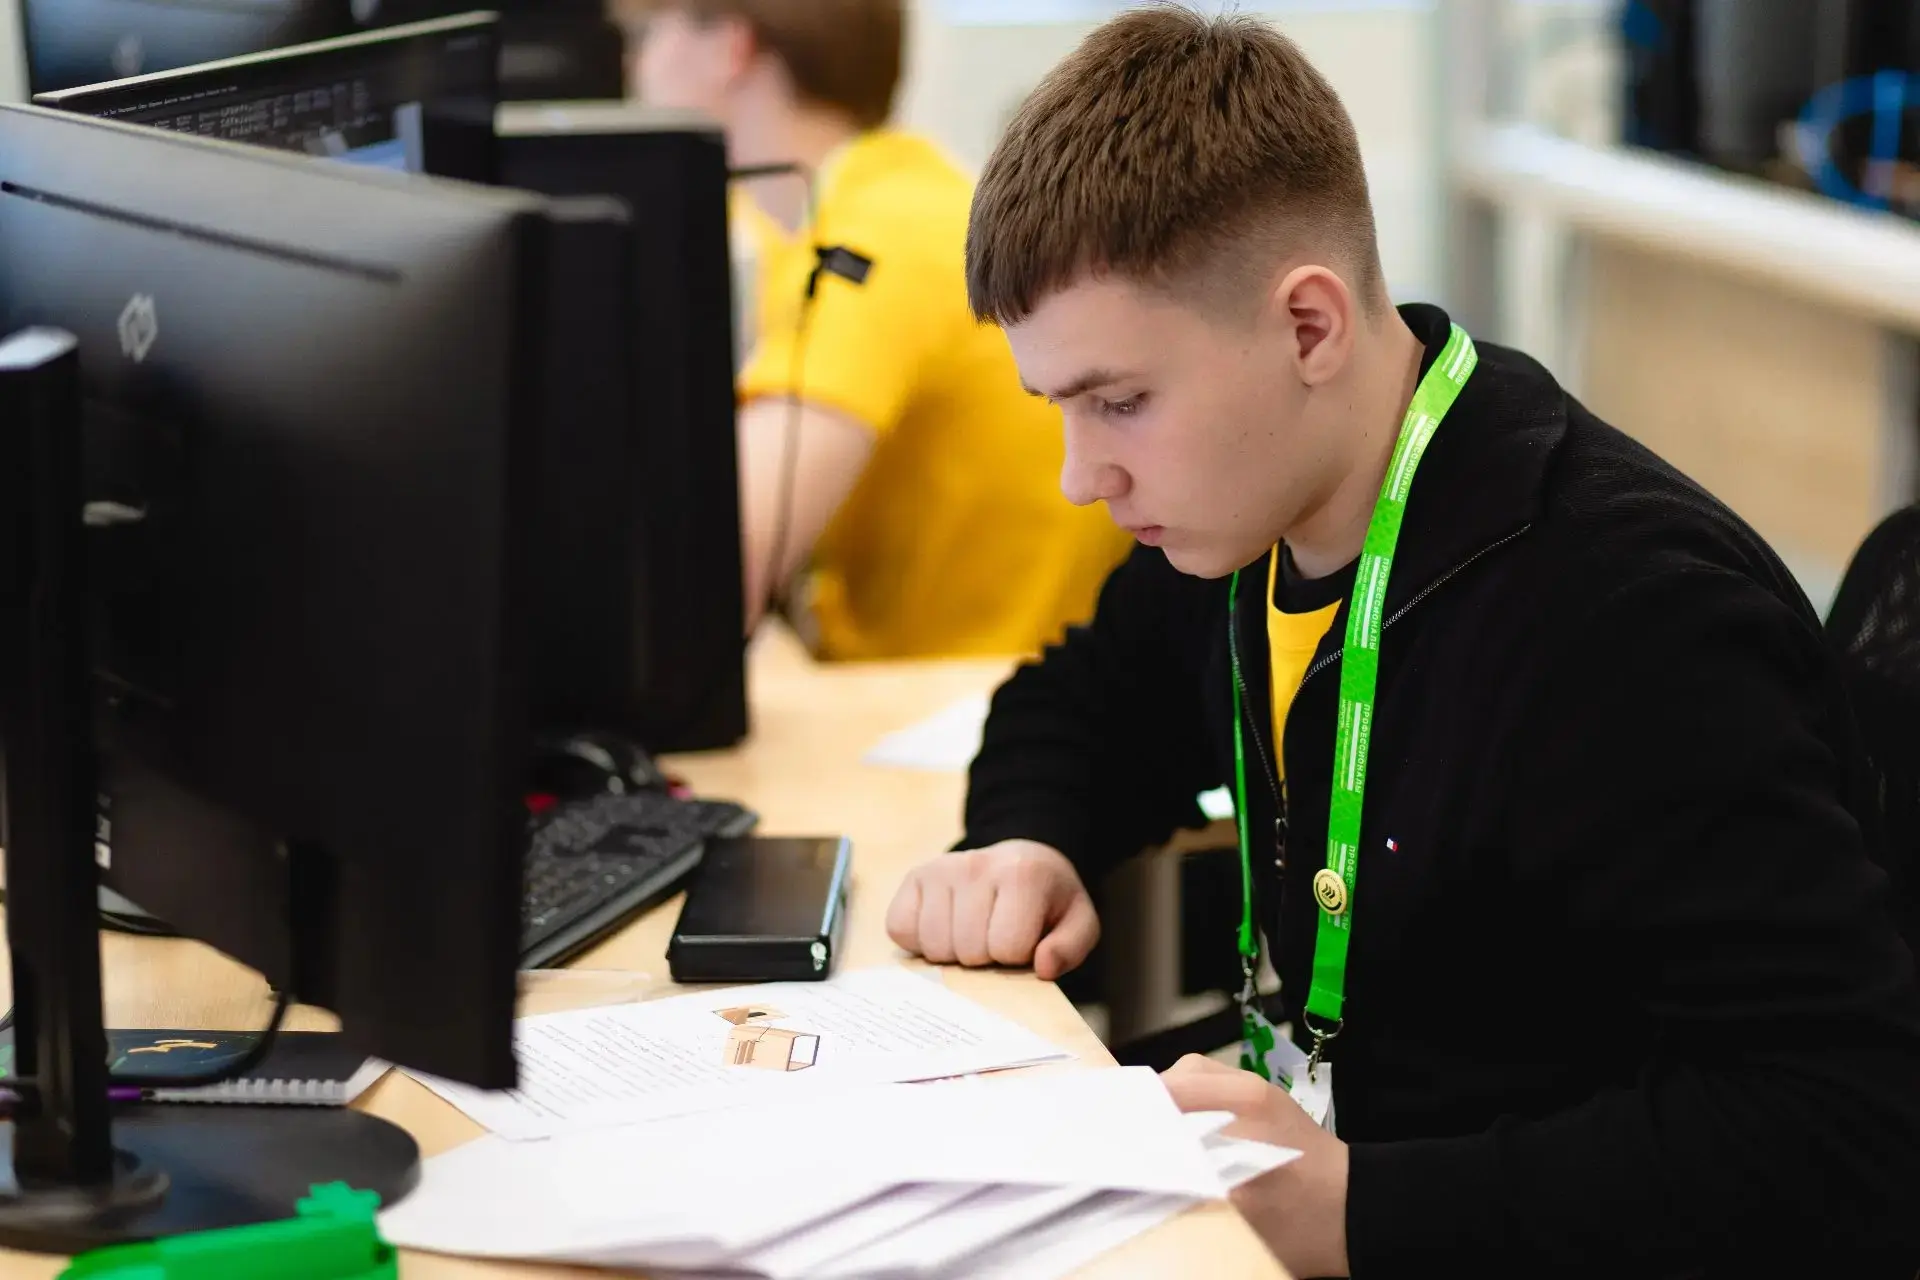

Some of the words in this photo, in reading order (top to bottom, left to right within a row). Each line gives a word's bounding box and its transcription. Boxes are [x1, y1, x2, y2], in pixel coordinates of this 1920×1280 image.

[1396, 416, 1439, 502] ПРССИОНАЛЫ
[1369, 557, 1390, 650] ПРОФЕССИОНАЛЫ
[1354, 703, 1370, 793] ПРОФЕССИОНАЛЫ
[1341, 845, 1355, 930] ПРОФЕСЛЫ
